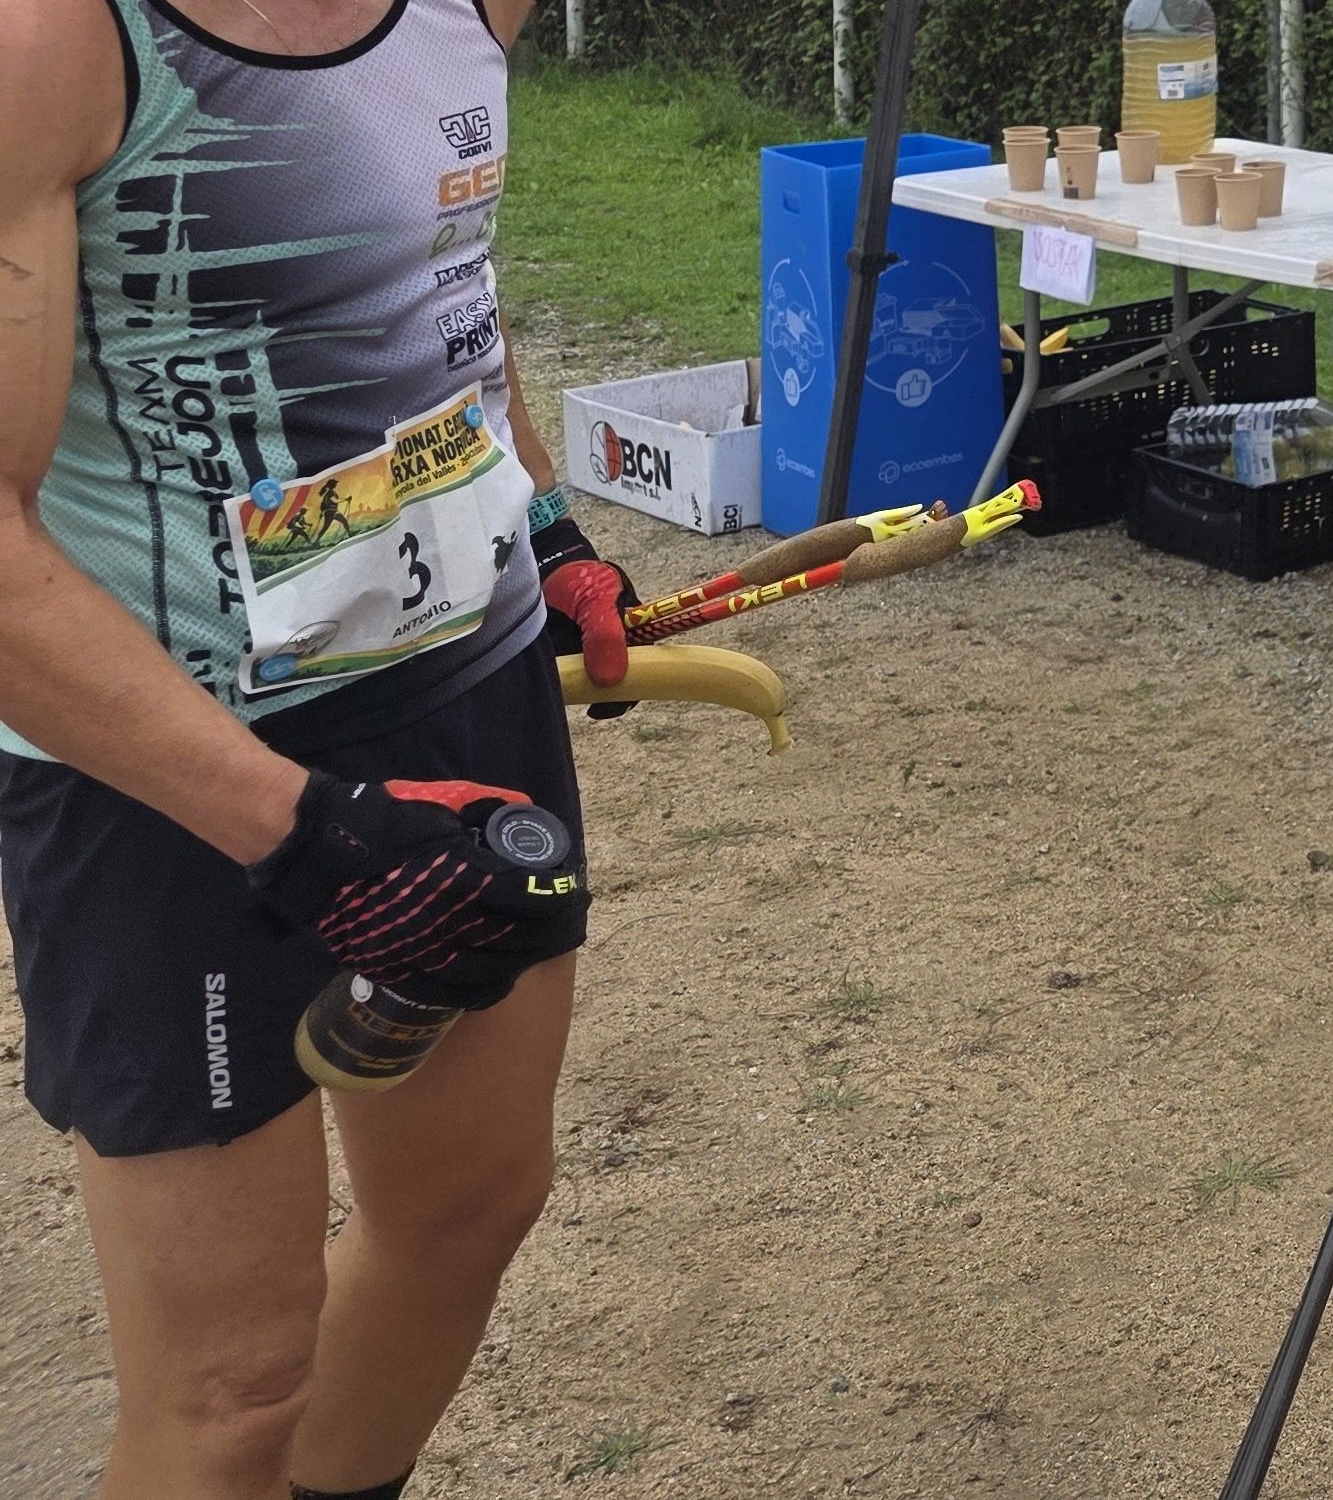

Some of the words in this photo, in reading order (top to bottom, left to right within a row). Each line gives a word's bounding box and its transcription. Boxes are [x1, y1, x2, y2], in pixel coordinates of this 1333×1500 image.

[436, 292, 492, 341] EASY
[446, 307, 498, 365] PRINT
[127, 357, 185, 481] TEAM
[416, 473, 431, 487] del
[618, 437, 672, 491] BCN
[902, 452, 964, 473] ecoembes
[399, 532, 432, 611] 3
[205, 973, 233, 1109] SALOMON
